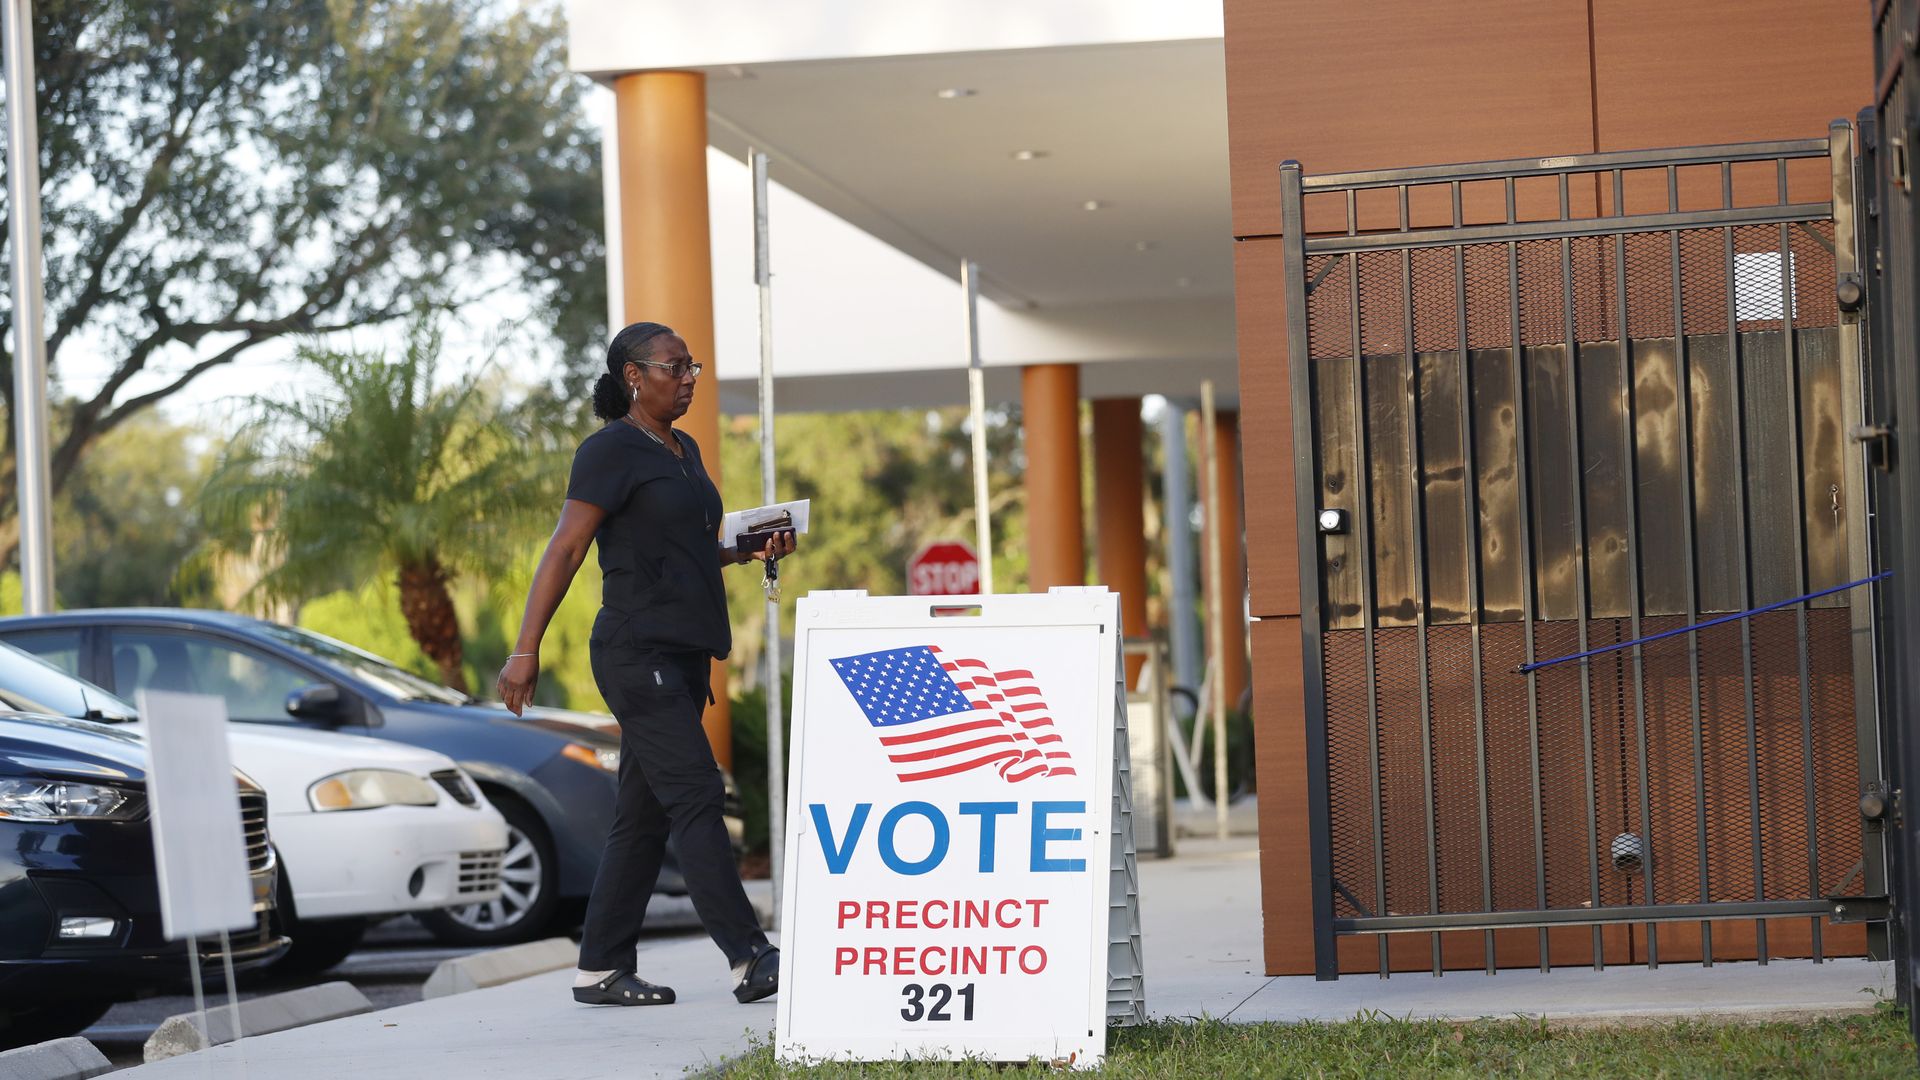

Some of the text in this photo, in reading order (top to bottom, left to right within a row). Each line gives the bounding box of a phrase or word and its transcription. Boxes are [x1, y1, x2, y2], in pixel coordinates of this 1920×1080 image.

[912, 561, 978, 594] STOP
[809, 801, 1086, 876] VOTE
[837, 899, 1049, 929] PRECINCT
[835, 945, 1048, 976] PRECINTO
[900, 983, 975, 1022] 321
